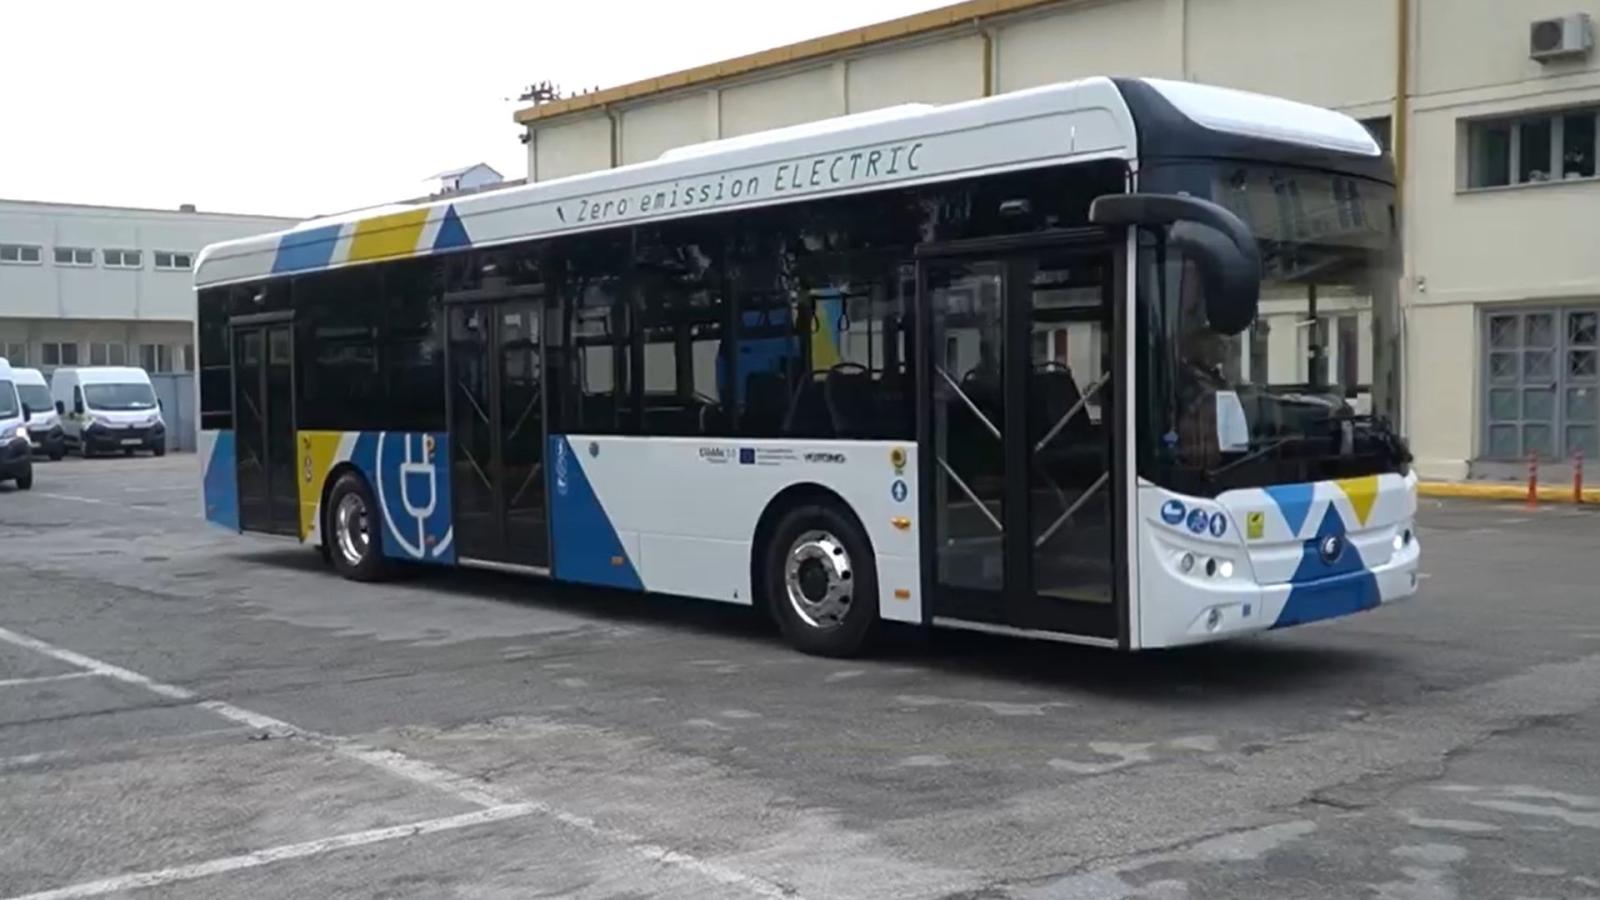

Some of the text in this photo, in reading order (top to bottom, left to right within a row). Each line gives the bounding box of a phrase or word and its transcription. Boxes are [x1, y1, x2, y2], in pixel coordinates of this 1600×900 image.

[576, 143, 923, 223] Zero emission ELECTRIC
